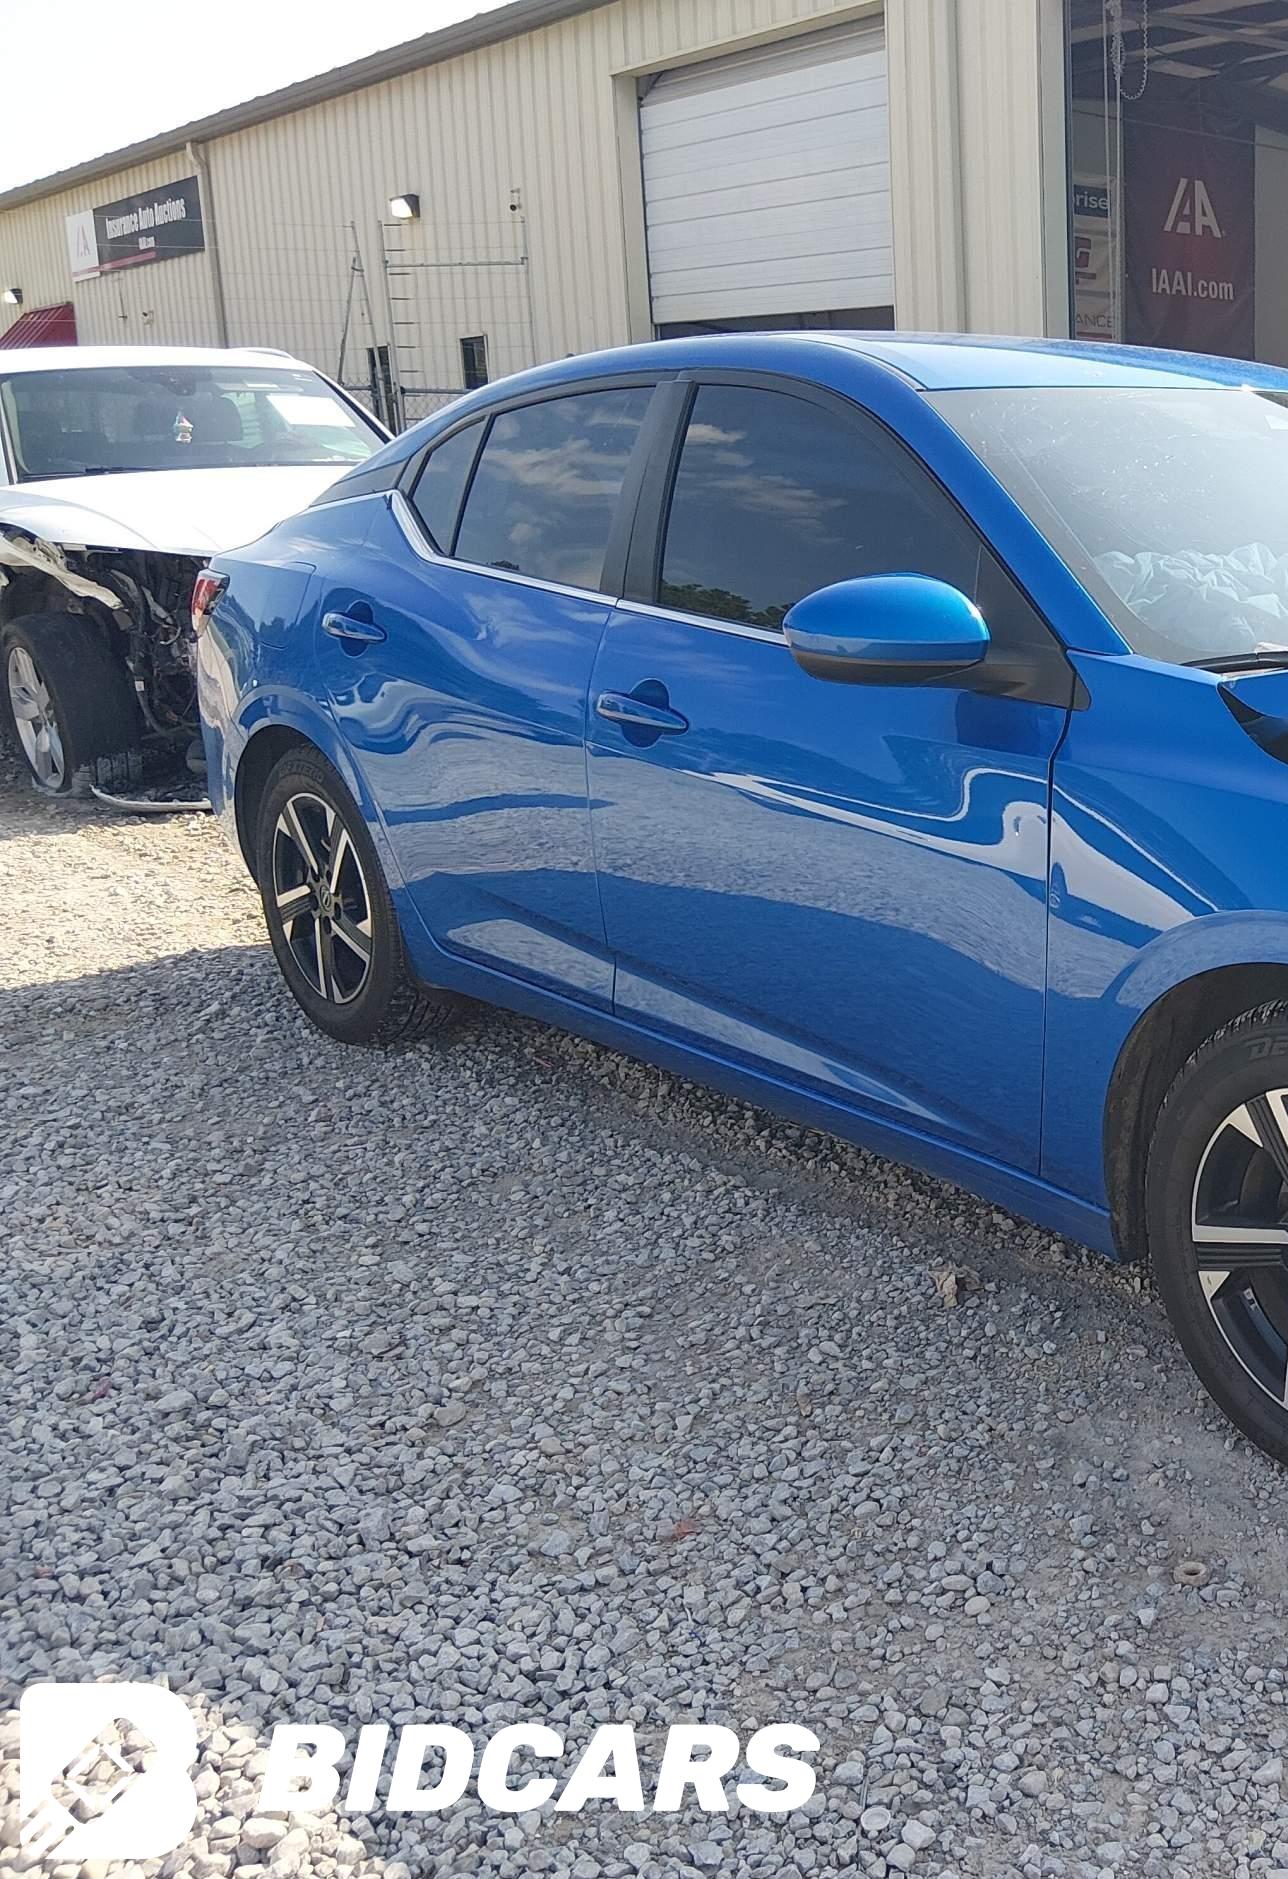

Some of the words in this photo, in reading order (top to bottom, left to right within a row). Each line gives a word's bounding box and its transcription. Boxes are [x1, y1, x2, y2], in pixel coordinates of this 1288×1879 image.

[1073, 190, 1109, 210] rise
[105, 212, 138, 239] Insurance
[138, 206, 154, 230] Auto
[154, 198, 187, 226] Auctions
[1151, 267, 1234, 301] IAAI.com
